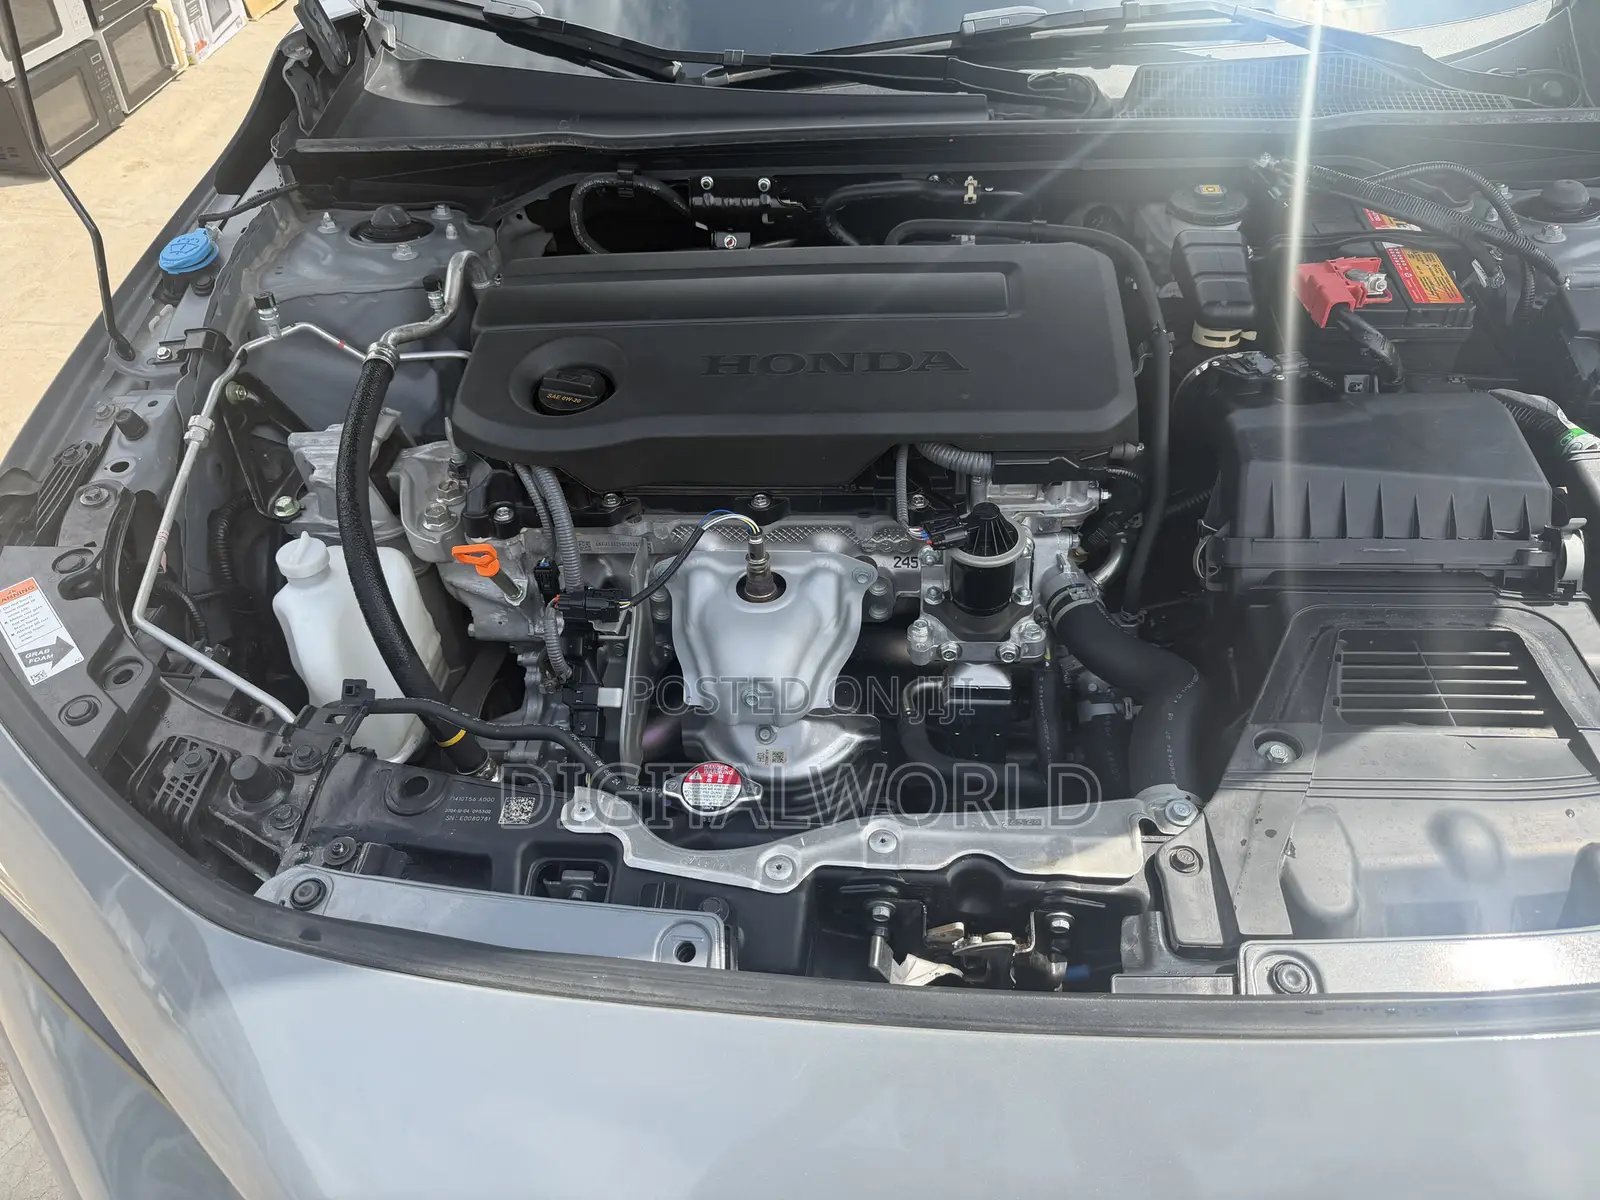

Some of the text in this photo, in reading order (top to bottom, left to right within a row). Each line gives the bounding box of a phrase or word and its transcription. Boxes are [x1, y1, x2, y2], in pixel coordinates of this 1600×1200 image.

[700, 350, 972, 376] HONDA
[893, 556, 919, 569] 245
[0, 585, 35, 603] ARNING
[25, 648, 50, 659] GRAB
[28, 653, 54, 664] FOAM
